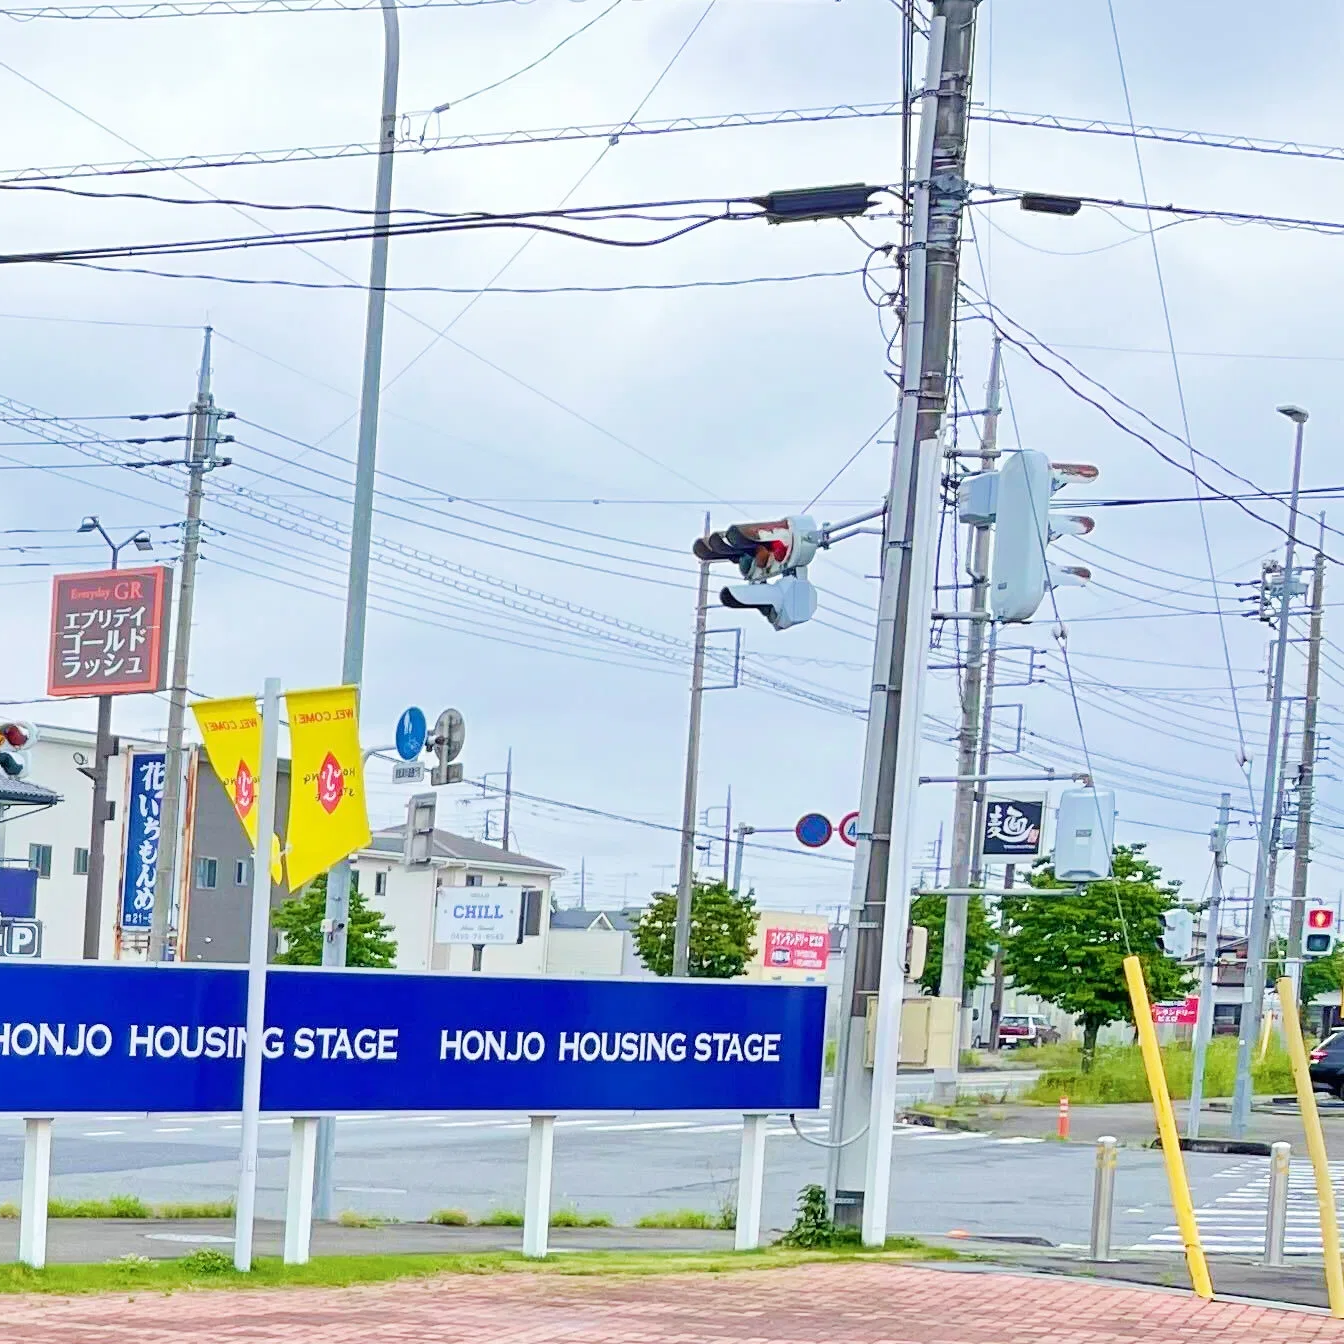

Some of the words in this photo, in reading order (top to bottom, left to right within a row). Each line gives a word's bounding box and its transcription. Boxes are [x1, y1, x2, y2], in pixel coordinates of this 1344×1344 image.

[114, 581, 144, 600] GR
[64, 606, 146, 630] エブリデイ
[62, 628, 147, 654] ゴールド
[62, 653, 143, 679] ラッシュ
[134, 761, 166, 911] 花いちもんめ
[987, 804, 1034, 843] 麺
[453, 904, 504, 919] CHILL
[12, 927, 33, 953] P
[128, 1024, 284, 1059] HOUSING
[293, 1028, 399, 1060] STAGE
[440, 1030, 545, 1061] HONJO
[558, 1031, 687, 1062] HOUSING
[694, 1033, 782, 1062] STAGE
